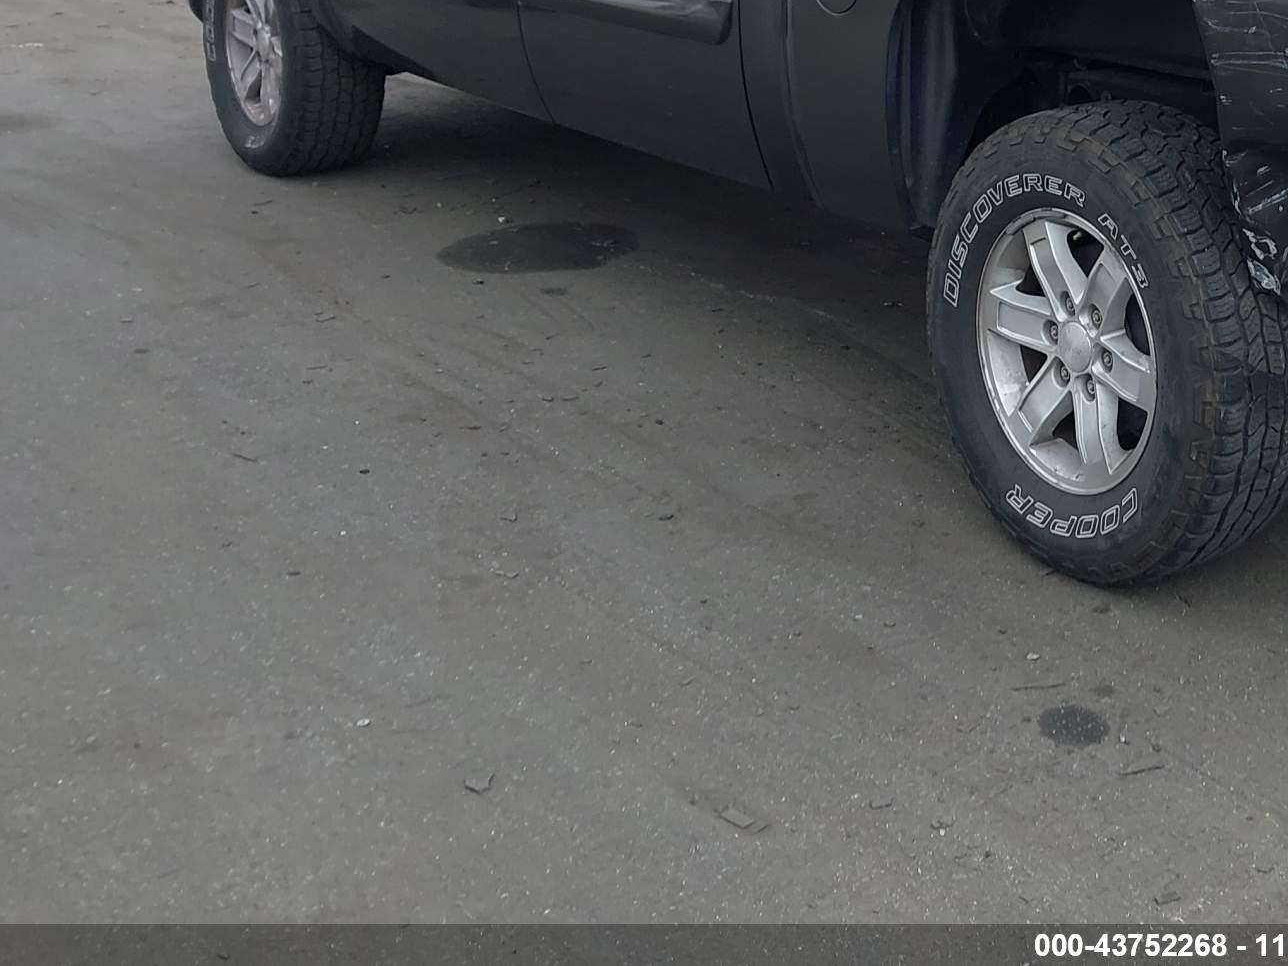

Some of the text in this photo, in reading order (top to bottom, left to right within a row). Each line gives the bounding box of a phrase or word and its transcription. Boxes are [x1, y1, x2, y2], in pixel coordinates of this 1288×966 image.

[943, 173, 1149, 308] DISCOVERER AT3
[1005, 483, 1138, 539] COOPER
